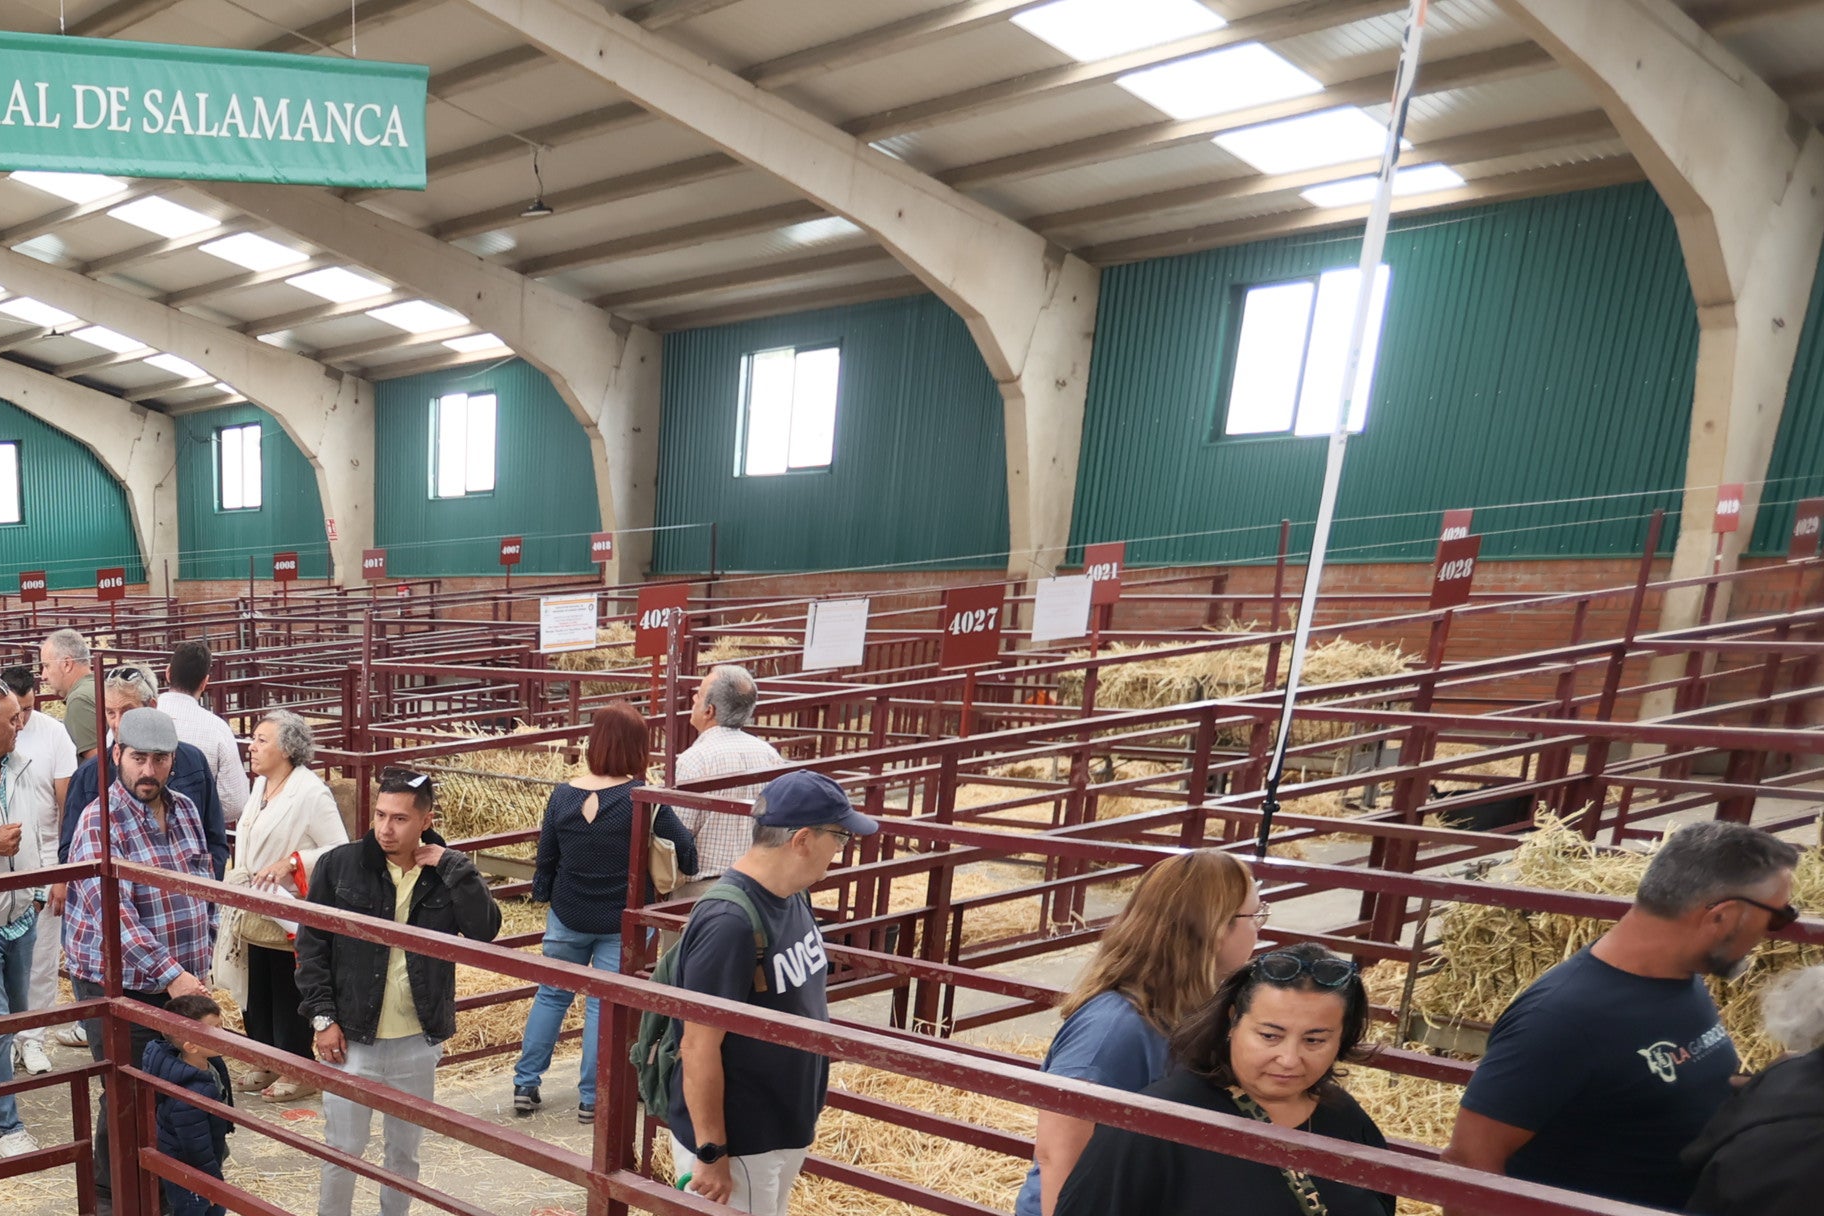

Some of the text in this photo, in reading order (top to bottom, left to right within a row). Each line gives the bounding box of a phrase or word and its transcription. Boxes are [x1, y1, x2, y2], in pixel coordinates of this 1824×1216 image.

[71, 84, 131, 133] DE
[142, 89, 409, 148] SALAMANCA
[363, 557, 384, 568] 4017
[1086, 562, 1119, 582] 4021
[1437, 557, 1474, 582] 4028
[98, 577, 122, 589] 4016
[948, 607, 999, 636] 4027
[1669, 1047, 1691, 1065] LA
